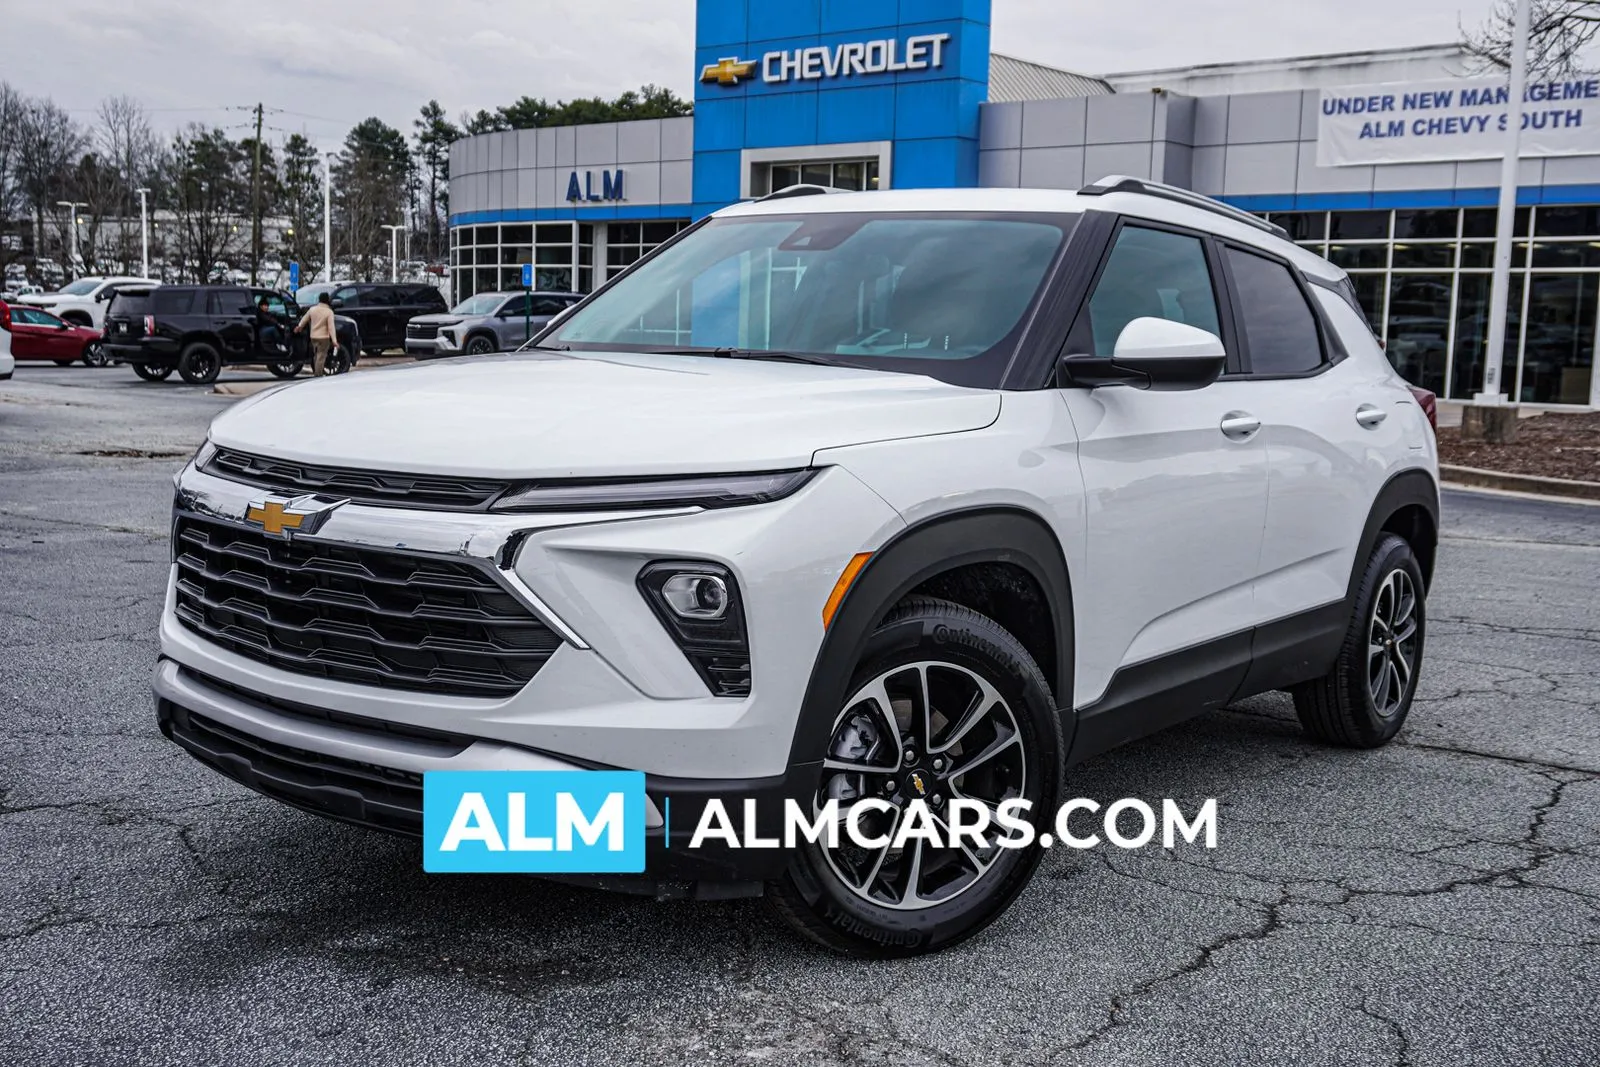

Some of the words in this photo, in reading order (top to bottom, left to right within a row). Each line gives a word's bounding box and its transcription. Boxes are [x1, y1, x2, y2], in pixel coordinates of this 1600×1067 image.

[762, 33, 951, 83] CHEVROLET
[1322, 94, 1394, 115] UNDER
[1402, 90, 1453, 111] NEW
[1359, 121, 1405, 139] ALM
[1412, 115, 1491, 136] CHEVY
[566, 169, 624, 202] ALM
